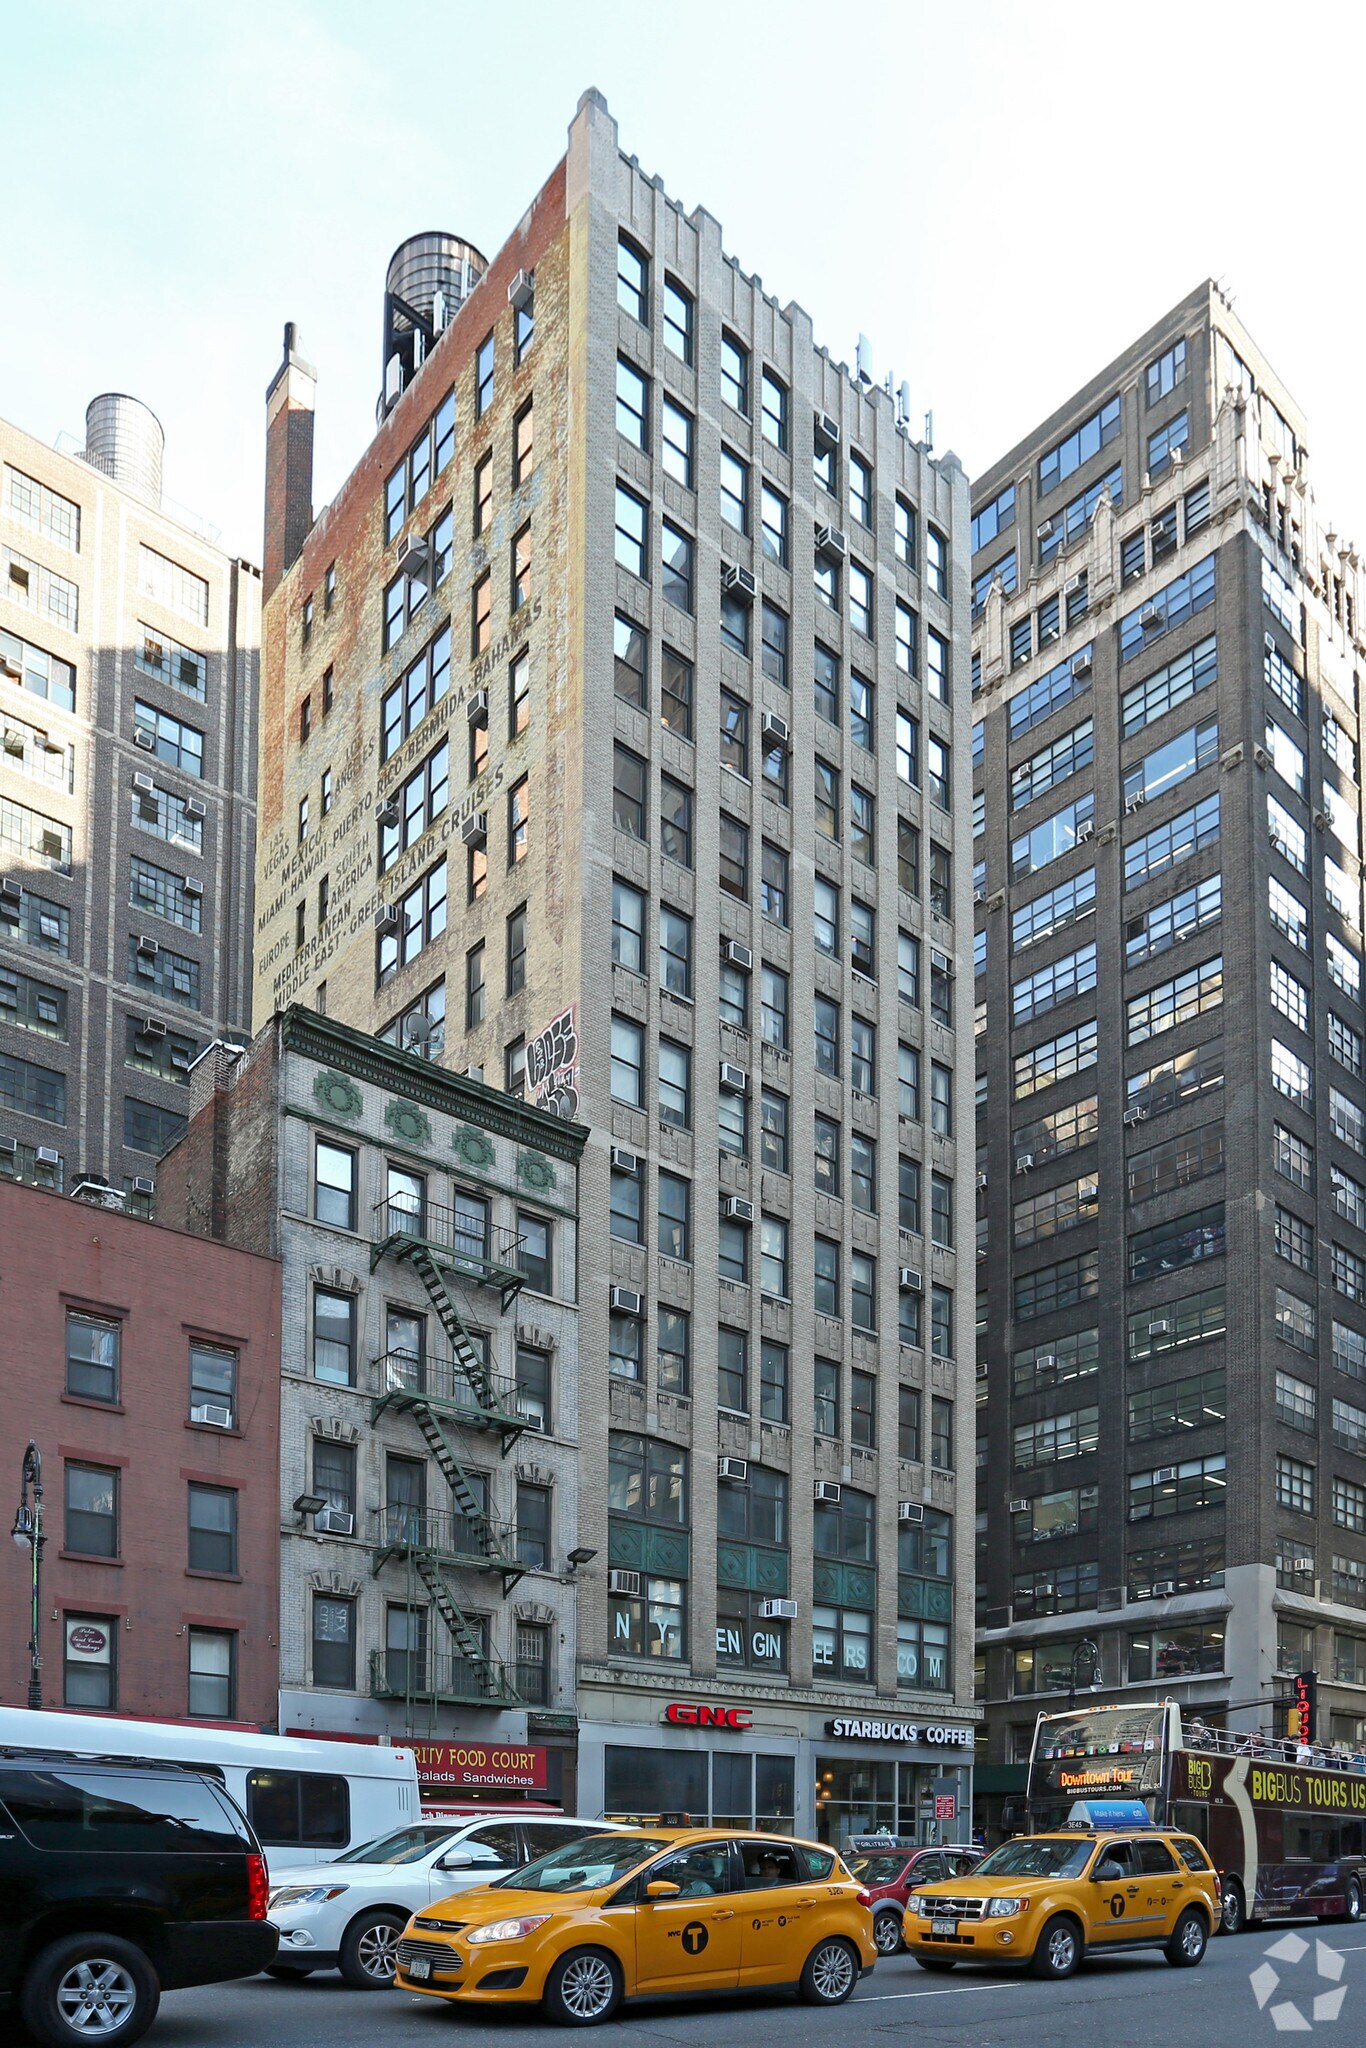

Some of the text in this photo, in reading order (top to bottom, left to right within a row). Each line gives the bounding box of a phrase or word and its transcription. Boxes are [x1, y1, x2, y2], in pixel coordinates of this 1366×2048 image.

[335, 736, 374, 800] ANGES
[258, 893, 287, 934] MIAMI
[333, 791, 373, 848] PUERTO
[376, 755, 402, 798] RICO
[281, 825, 322, 886] MEXICO
[335, 831, 370, 882] SOUTH
[263, 838, 290, 880] VEGAS
[273, 762, 504, 1013] MIDDLE EAST GREEK ISLAND CRUISES
[330, 852, 373, 910] AMERICA
[258, 930, 291, 977] EUROPE
[273, 897, 351, 995] MEDITERRANEAN
[665, 1703, 753, 1728] GNC
[833, 1718, 973, 1745] STARBUCKS COFFEE
[449, 1748, 487, 1768] FOOD
[491, 1751, 536, 1771] COURT
[1188, 1759, 1201, 1775] BIG
[415, 1770, 534, 1786] Salads Sandwiches
[1061, 1768, 1134, 1787] Downtown Tour
[1066, 1785, 1122, 1795] BIGBUSTOURS.COM
[1188, 1775, 1202, 1790] BUS
[1193, 1789, 1208, 1798] TOURS
[1305, 1777, 1348, 1808] TOURS
[1068, 1821, 1082, 1829] 3E45
[1094, 1809, 1107, 1818] Make
[667, 1930, 681, 1938] NYC
